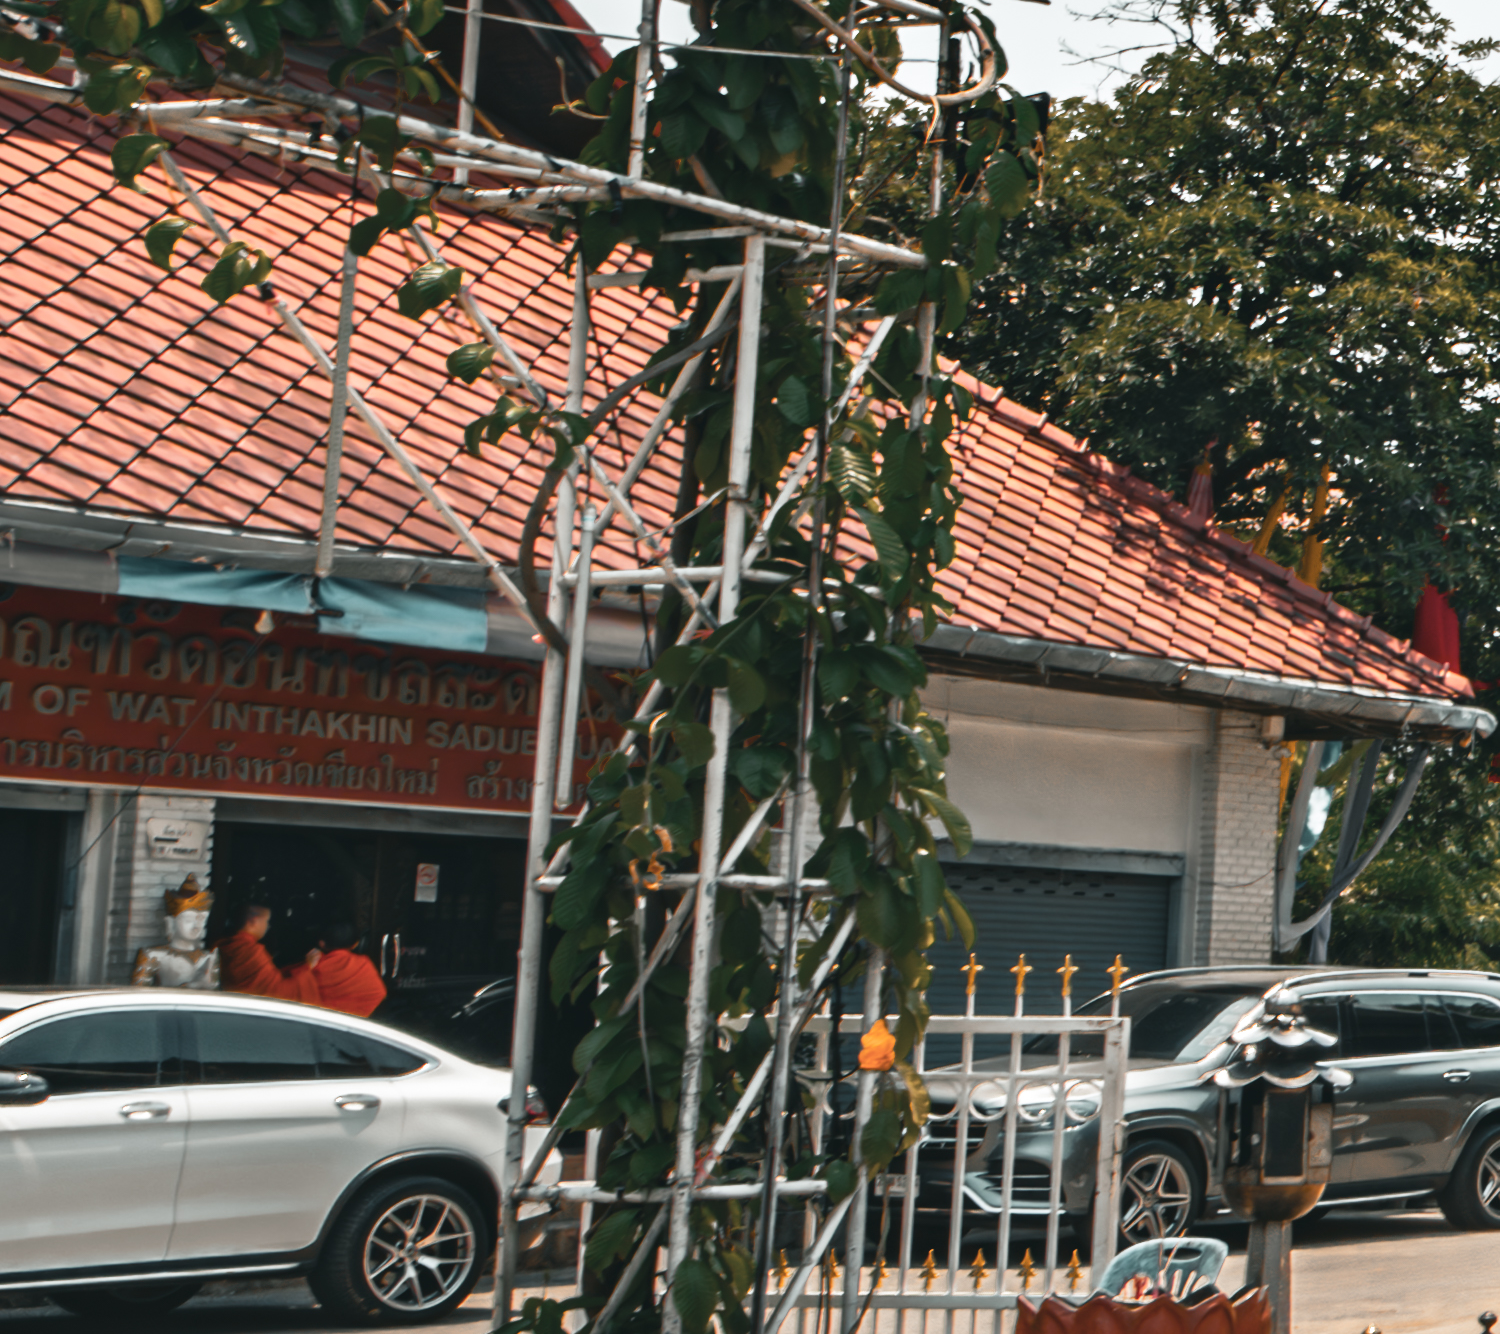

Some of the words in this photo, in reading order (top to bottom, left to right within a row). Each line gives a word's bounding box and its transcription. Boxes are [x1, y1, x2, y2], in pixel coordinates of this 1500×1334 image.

[32, 684, 92, 717] OF
[106, 690, 197, 727] WAT
[211, 701, 413, 745] INTHAKHIN
